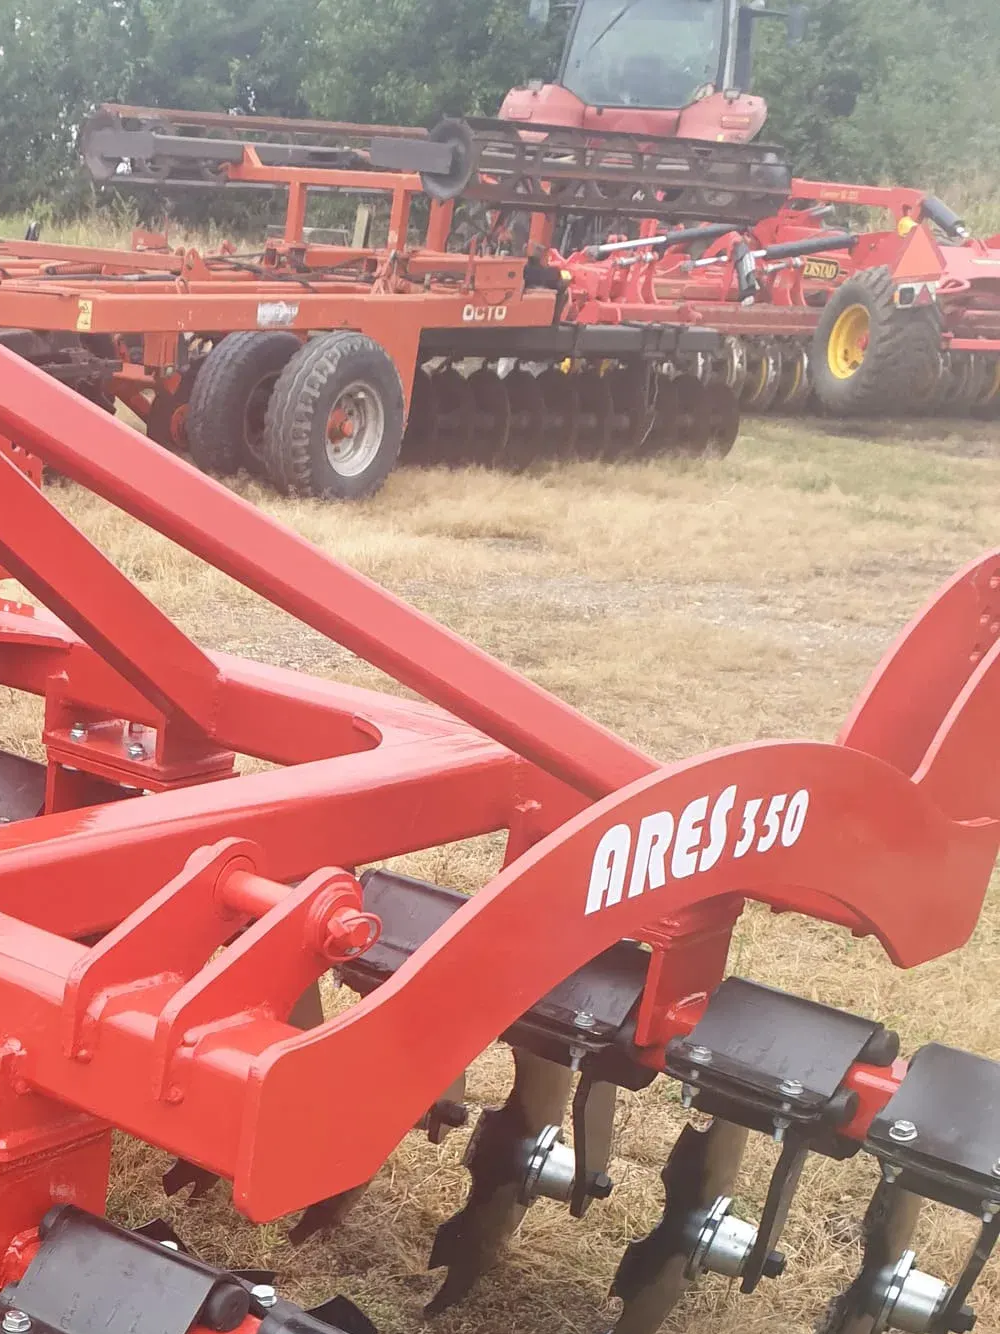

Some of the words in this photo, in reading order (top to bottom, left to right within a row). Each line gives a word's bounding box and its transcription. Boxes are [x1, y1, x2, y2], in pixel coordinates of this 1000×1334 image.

[463, 303, 507, 321] OCTO
[584, 784, 737, 916] ARES
[733, 788, 810, 859] 350
